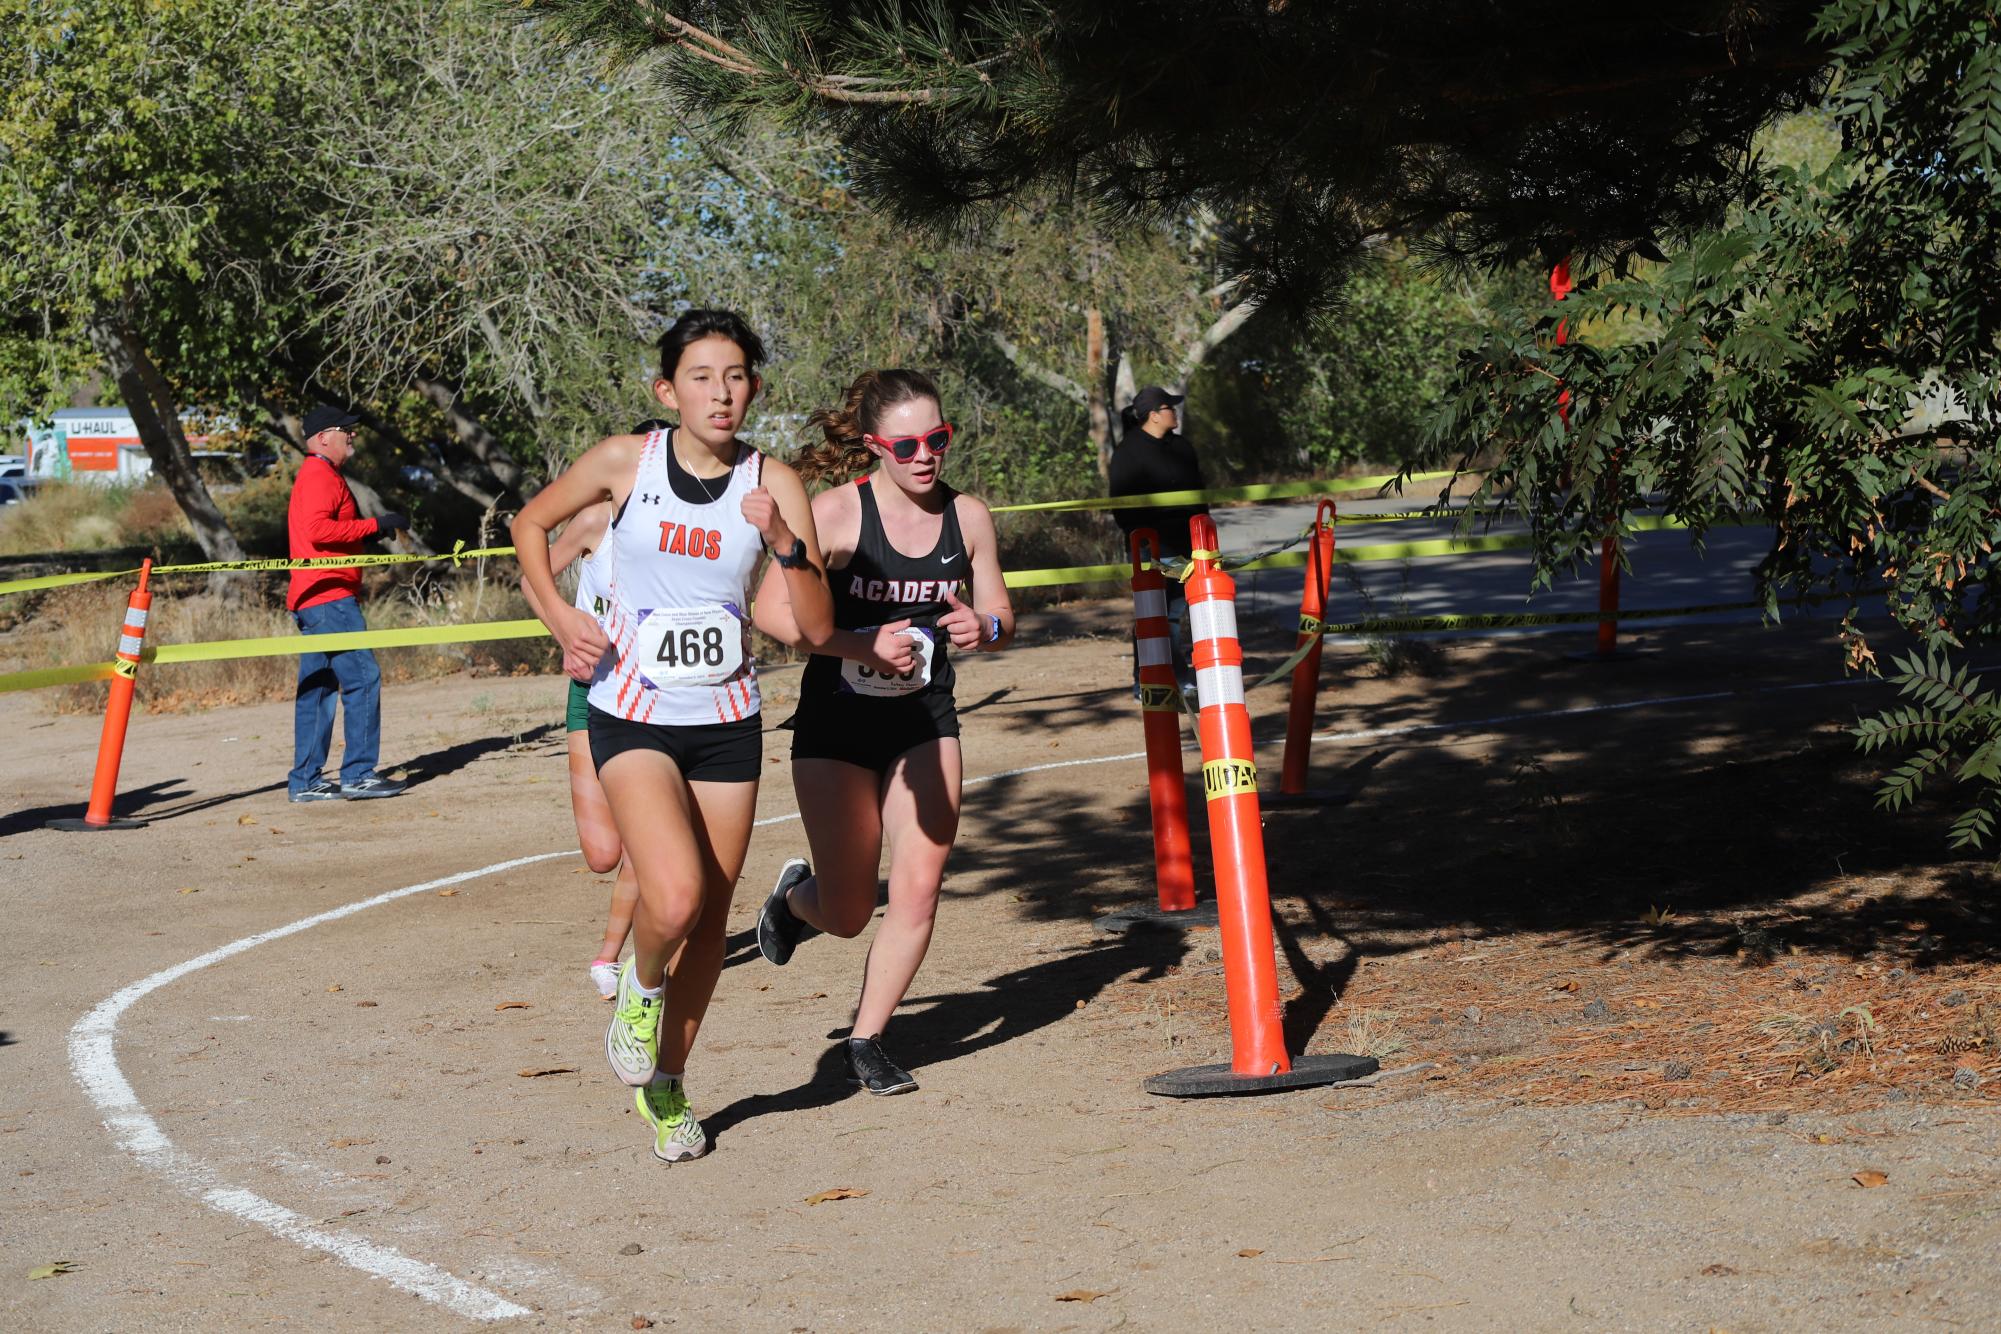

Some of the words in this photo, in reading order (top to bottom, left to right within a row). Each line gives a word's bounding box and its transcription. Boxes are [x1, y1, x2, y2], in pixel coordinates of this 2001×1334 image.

[71, 422, 117, 434] U-HAUL
[658, 520, 722, 560] TAOS
[849, 575, 964, 603] ACADEM
[656, 626, 724, 668] 468
